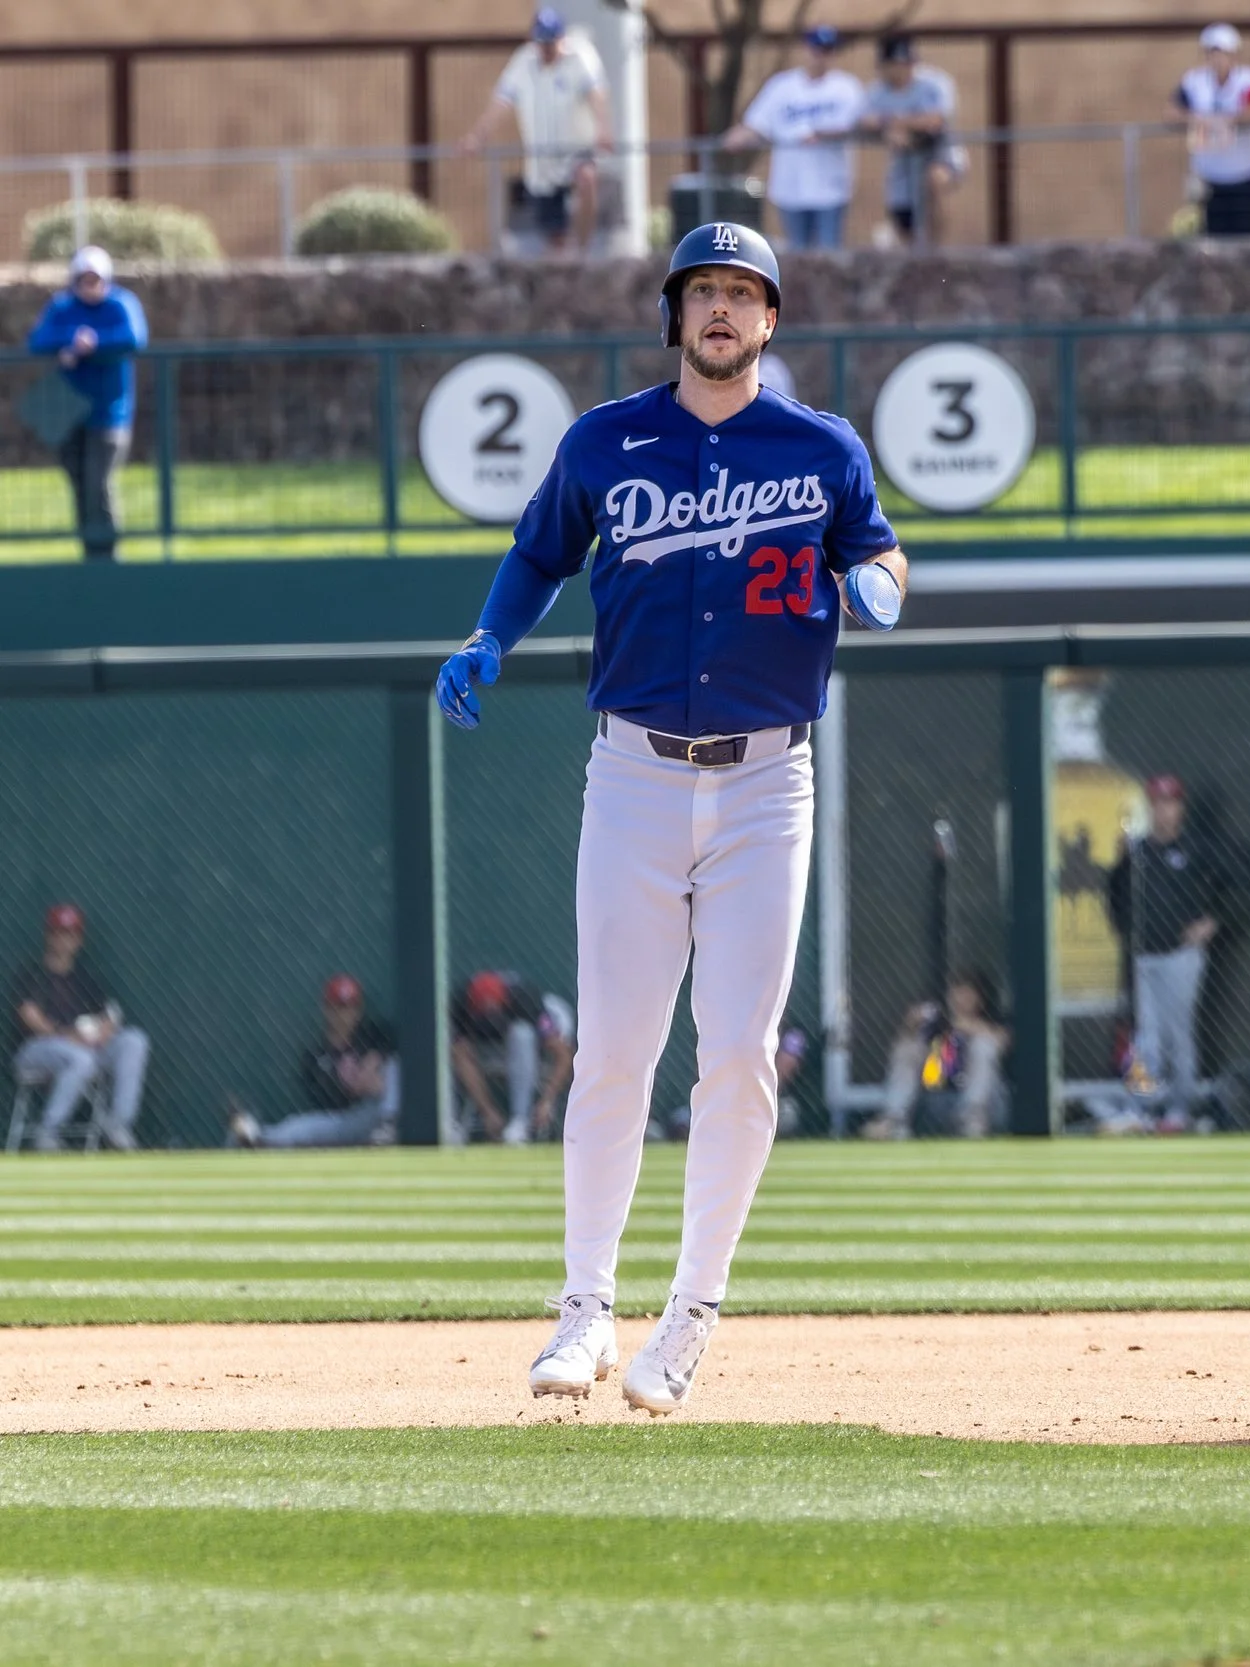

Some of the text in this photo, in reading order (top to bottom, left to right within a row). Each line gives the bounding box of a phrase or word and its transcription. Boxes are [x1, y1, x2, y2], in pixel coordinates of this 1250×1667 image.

[712, 223, 738, 252] LA
[475, 391, 523, 455] 2
[932, 379, 977, 445] 3
[606, 468, 828, 558] Dodgers
[745, 546, 815, 615] 23
